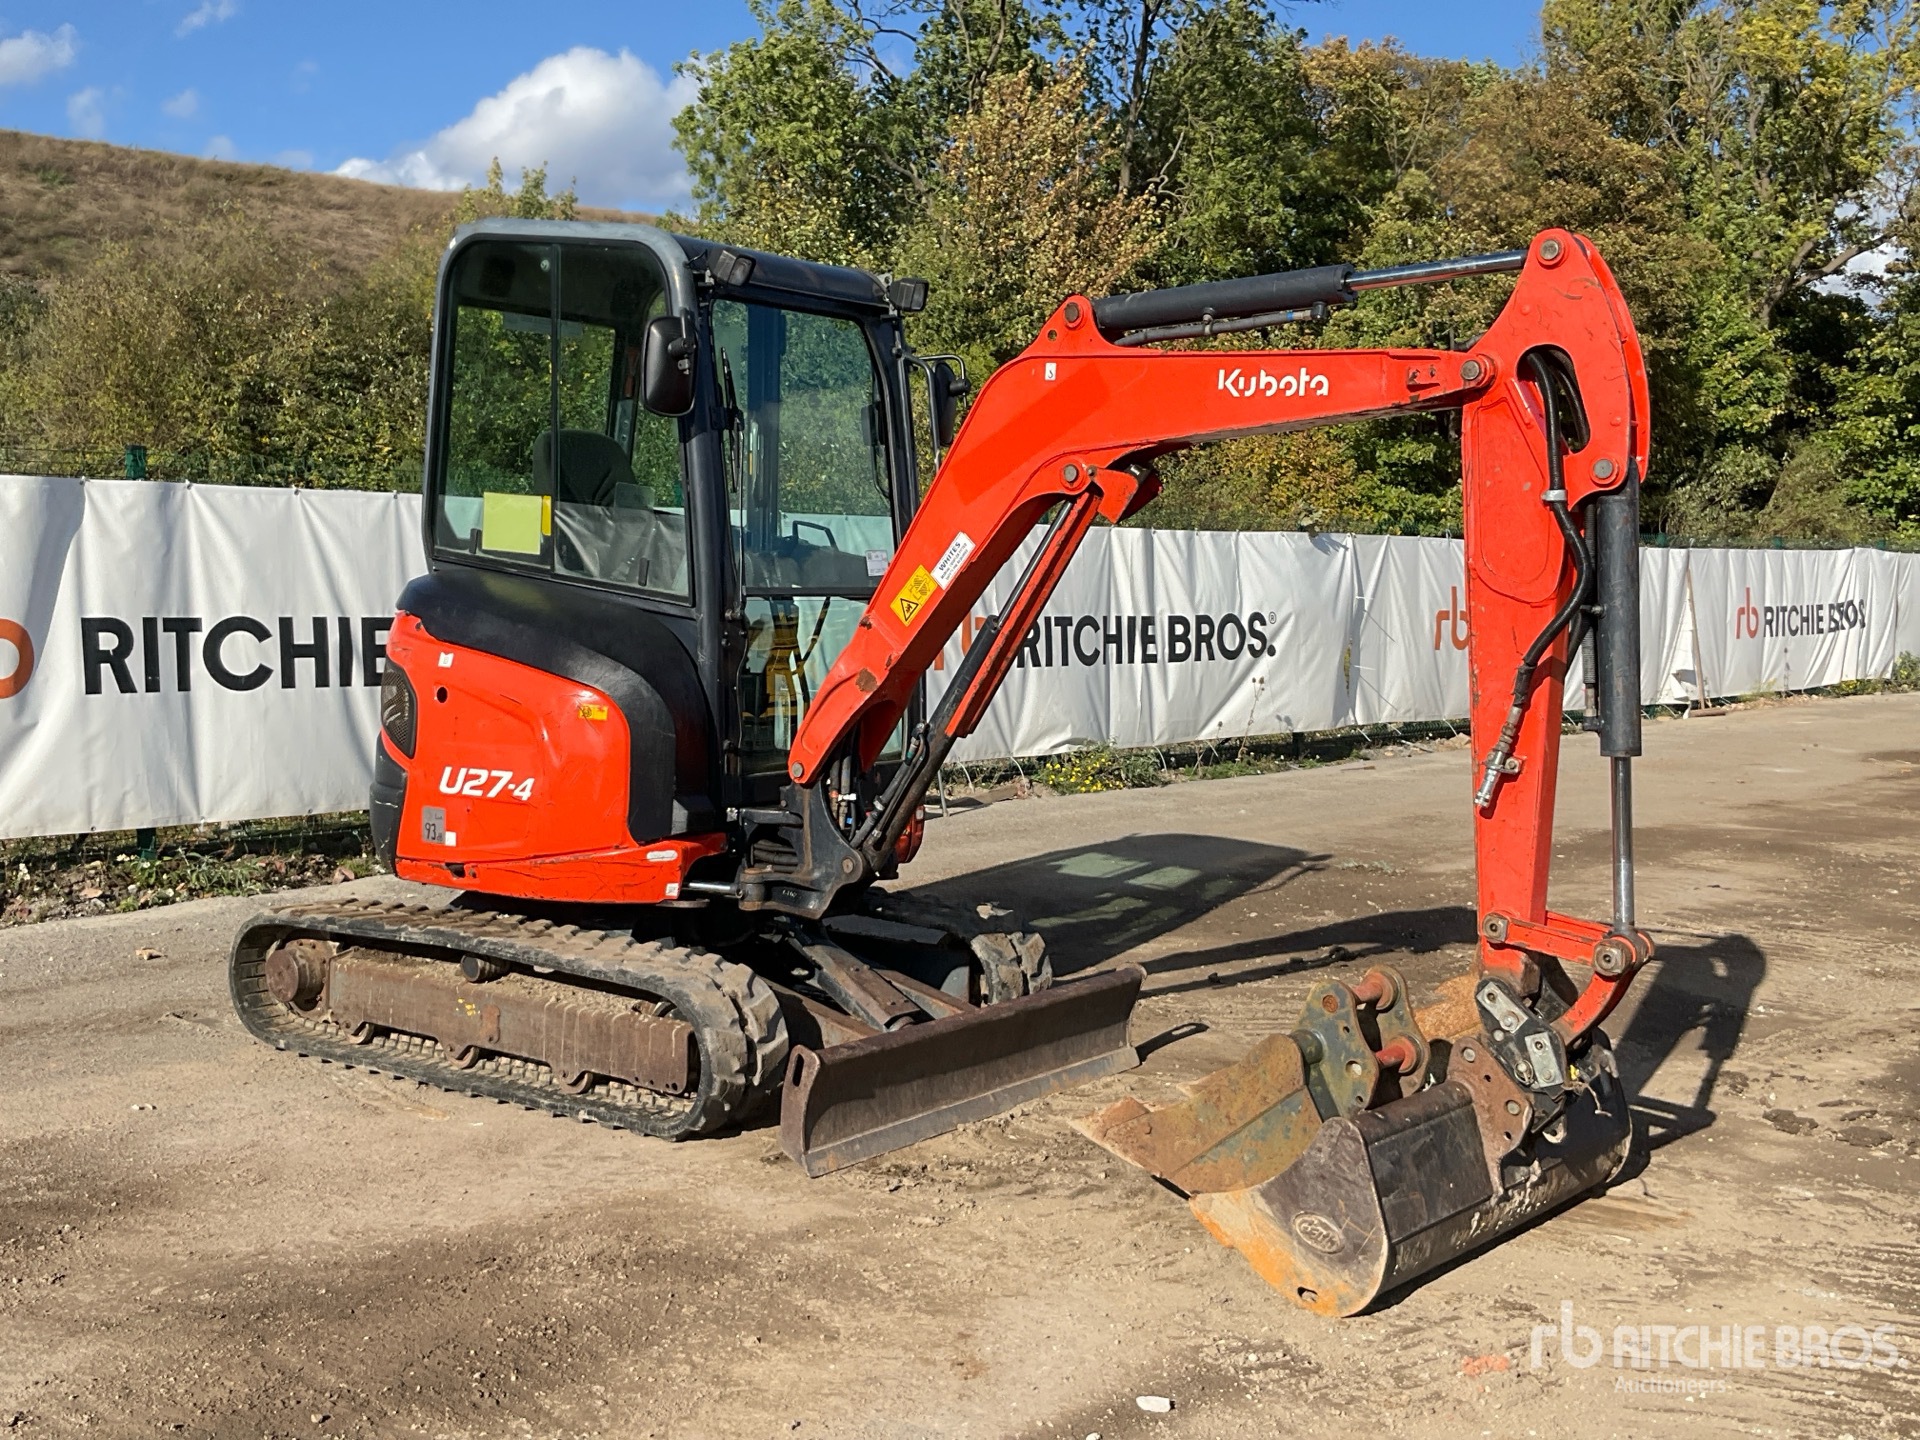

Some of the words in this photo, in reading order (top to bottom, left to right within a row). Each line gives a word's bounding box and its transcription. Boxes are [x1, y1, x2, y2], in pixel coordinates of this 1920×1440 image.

[1218, 367, 1329, 397] Kubota
[938, 542, 962, 571] WHITES
[1763, 604, 1824, 638] RITCHIE
[439, 766, 535, 801] U27-4
[425, 822, 436, 840] 93
